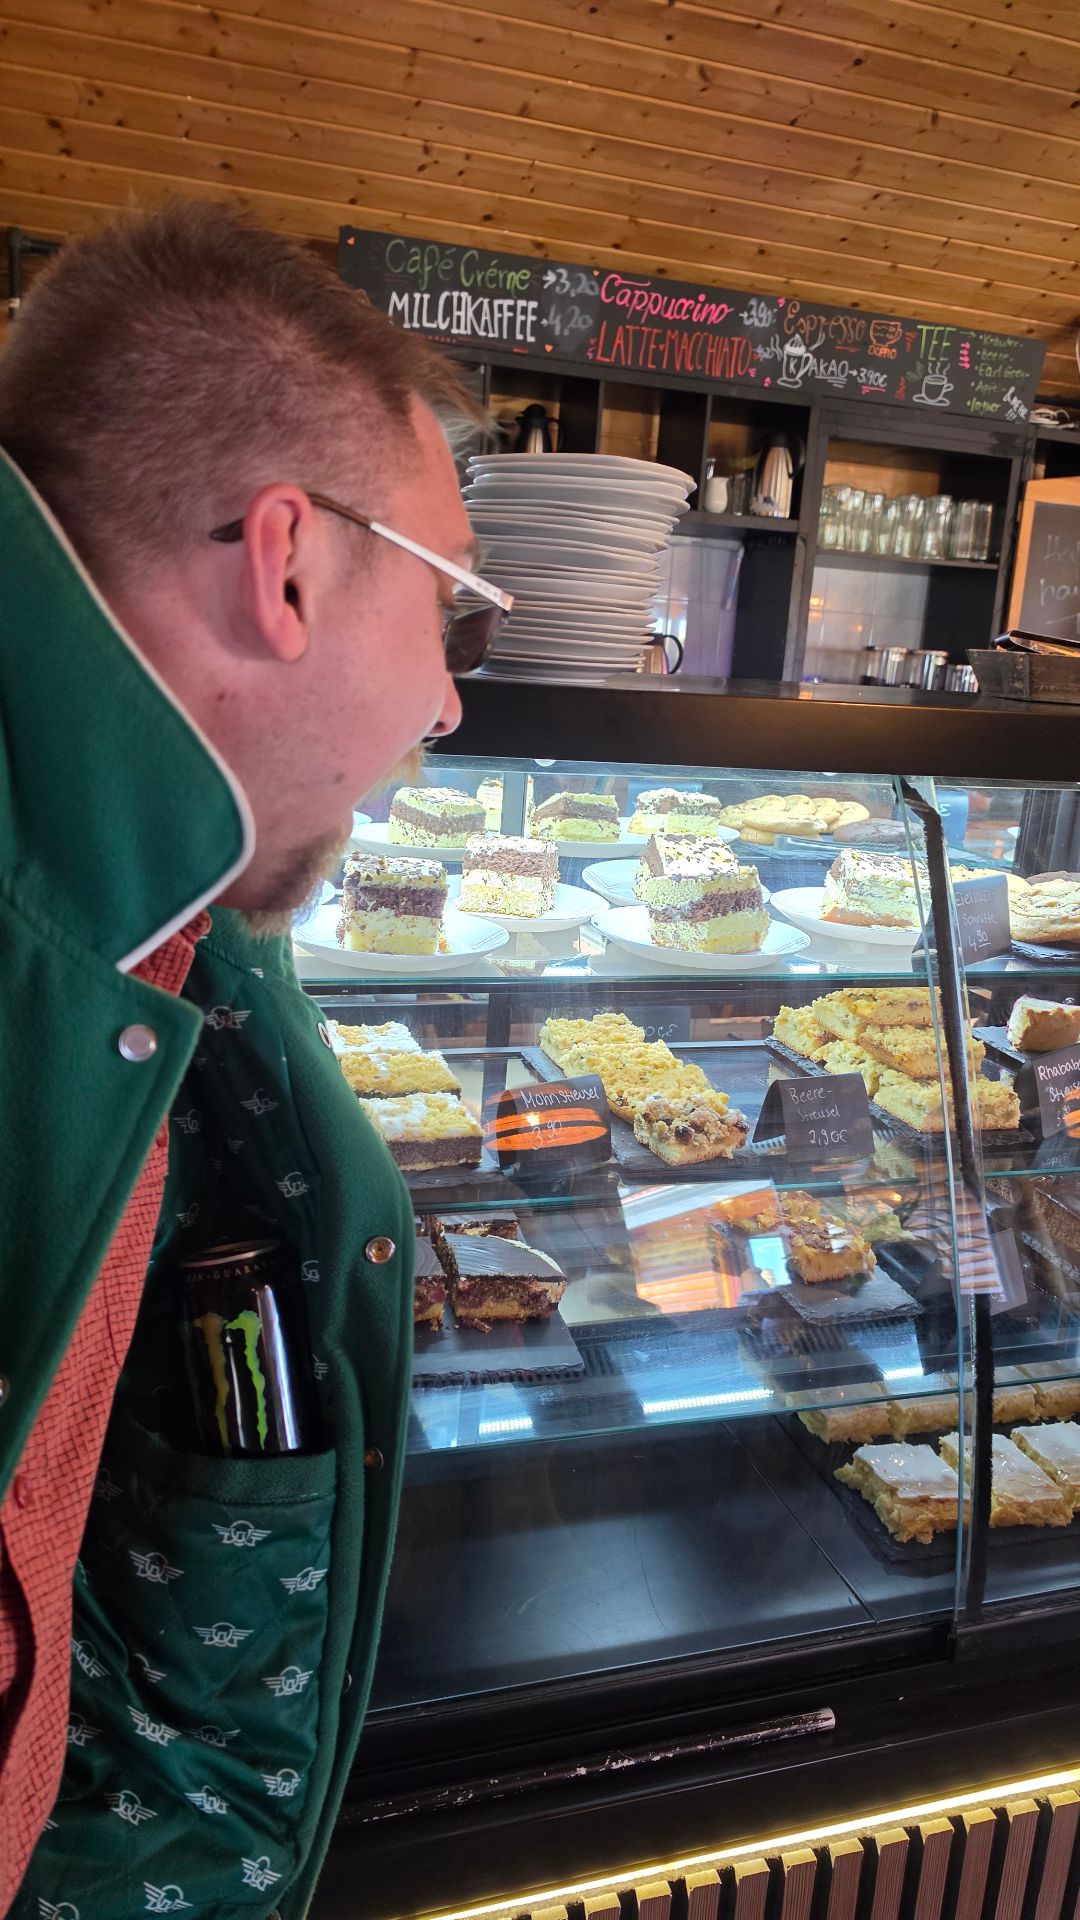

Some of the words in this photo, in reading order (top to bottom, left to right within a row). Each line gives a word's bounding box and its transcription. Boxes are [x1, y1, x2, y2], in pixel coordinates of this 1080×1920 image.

[386, 239, 456, 290] Café
[388, 291, 538, 342] MILCHKAFFEE
[784, 301, 866, 344] Espresso
[596, 320, 656, 369] LATTE
[917, 325, 956, 361] TEE
[808, 1129, 847, 1146] 2,90€
